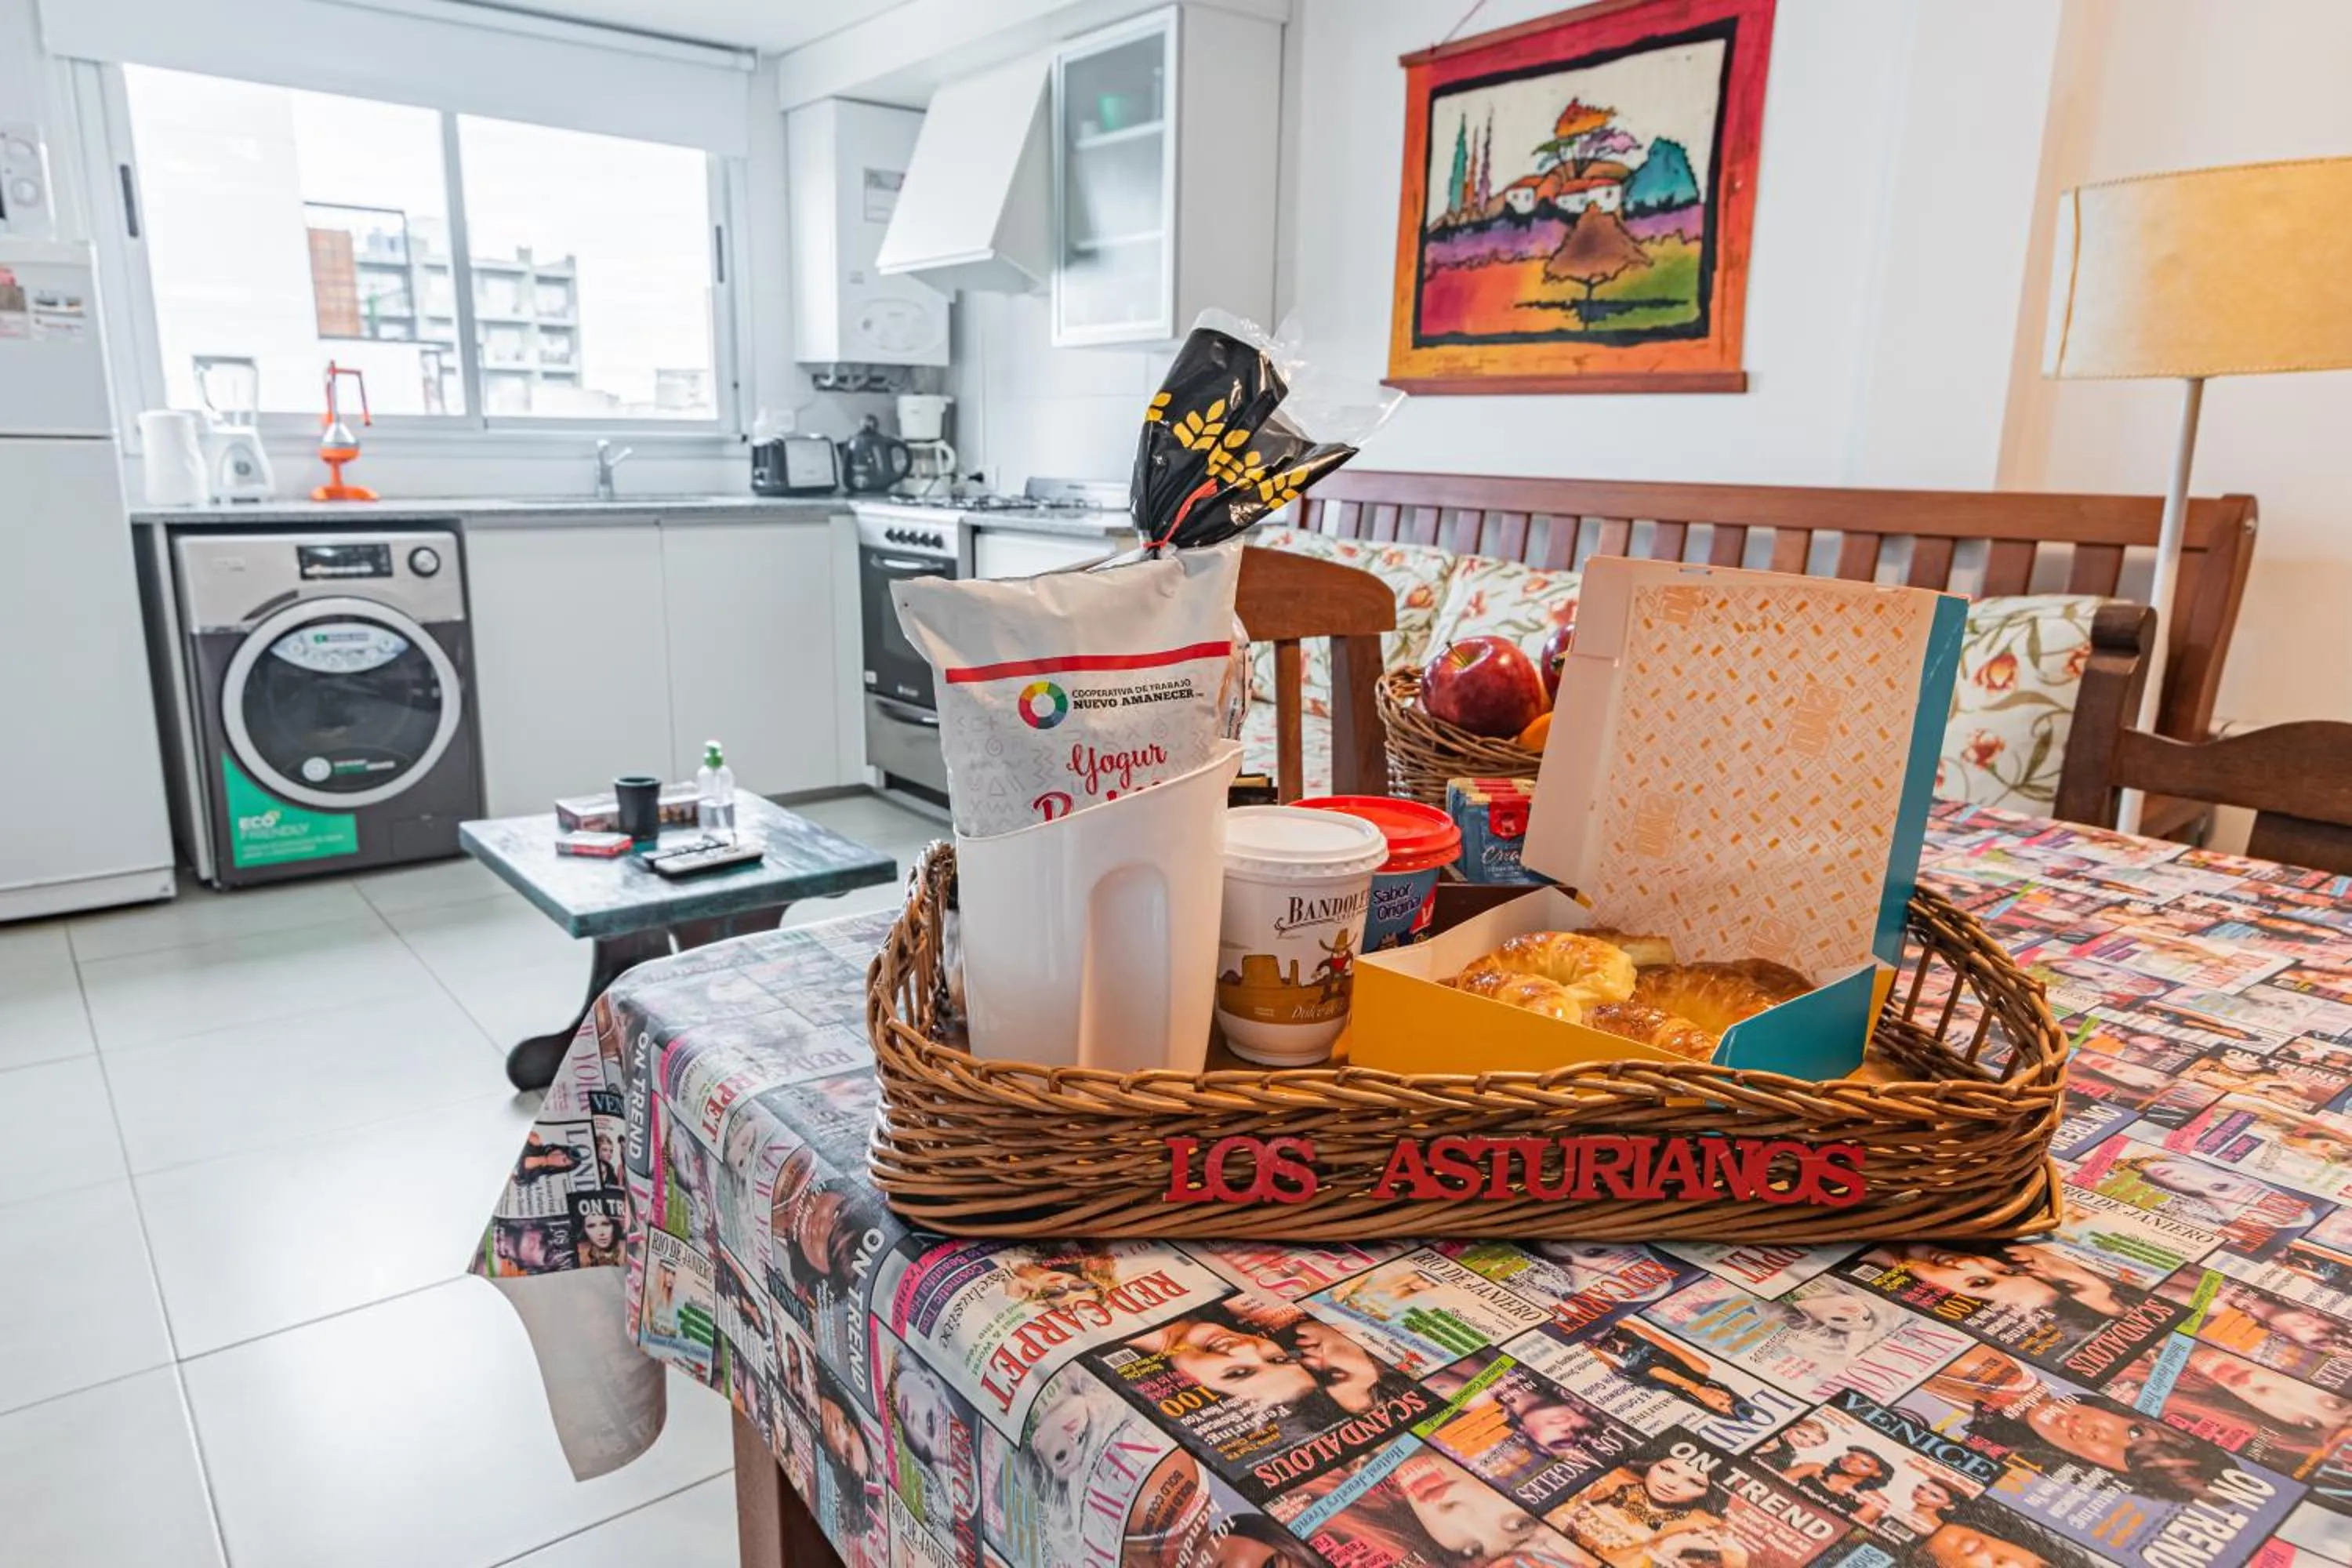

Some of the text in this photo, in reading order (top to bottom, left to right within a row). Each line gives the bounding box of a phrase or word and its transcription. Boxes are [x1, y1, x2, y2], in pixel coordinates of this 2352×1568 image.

[1072, 687, 1134, 699] COOPERATIVA
[1149, 678, 1191, 692] TRABAJO
[1073, 688, 1195, 710] NUEVO AMANECER
[1066, 743, 1167, 795] Yogur
[1373, 883, 1412, 906] Sabor
[1377, 896, 1423, 921] Original
[2227, 1047, 2259, 1065] ON
[630, 1032, 650, 1161] ON TREND
[1164, 1136, 1867, 1207] LOS ASTURIANOS
[578, 1199, 602, 1215] ON
[2122, 1204, 2216, 1245] JANIERO
[1106, 1269, 1190, 1316] RED
[1413, 1252, 1544, 1323] RIO DE JANIERO
[1933, 1293, 1984, 1320] 100
[847, 1228, 886, 1393] ON TREND
[979, 1298, 1113, 1417] CARPET
[2064, 1298, 2176, 1379] SCANDALOUS
[1158, 1386, 1220, 1417] 100
[1204, 1403, 1292, 1446] Featuring:
[1254, 1390, 1428, 1490] SCANDALOUS
[1590, 1421, 1645, 1457] LOS
[1843, 1392, 2000, 1484] VENICE
[1515, 1443, 1607, 1504] ANGELES
[1668, 1441, 1722, 1474] ON
[1722, 1467, 1835, 1541] TREND
[2212, 1467, 2278, 1507] ON
[1208, 1515, 1237, 1550] 101
[2139, 1498, 2252, 1568] TREND
